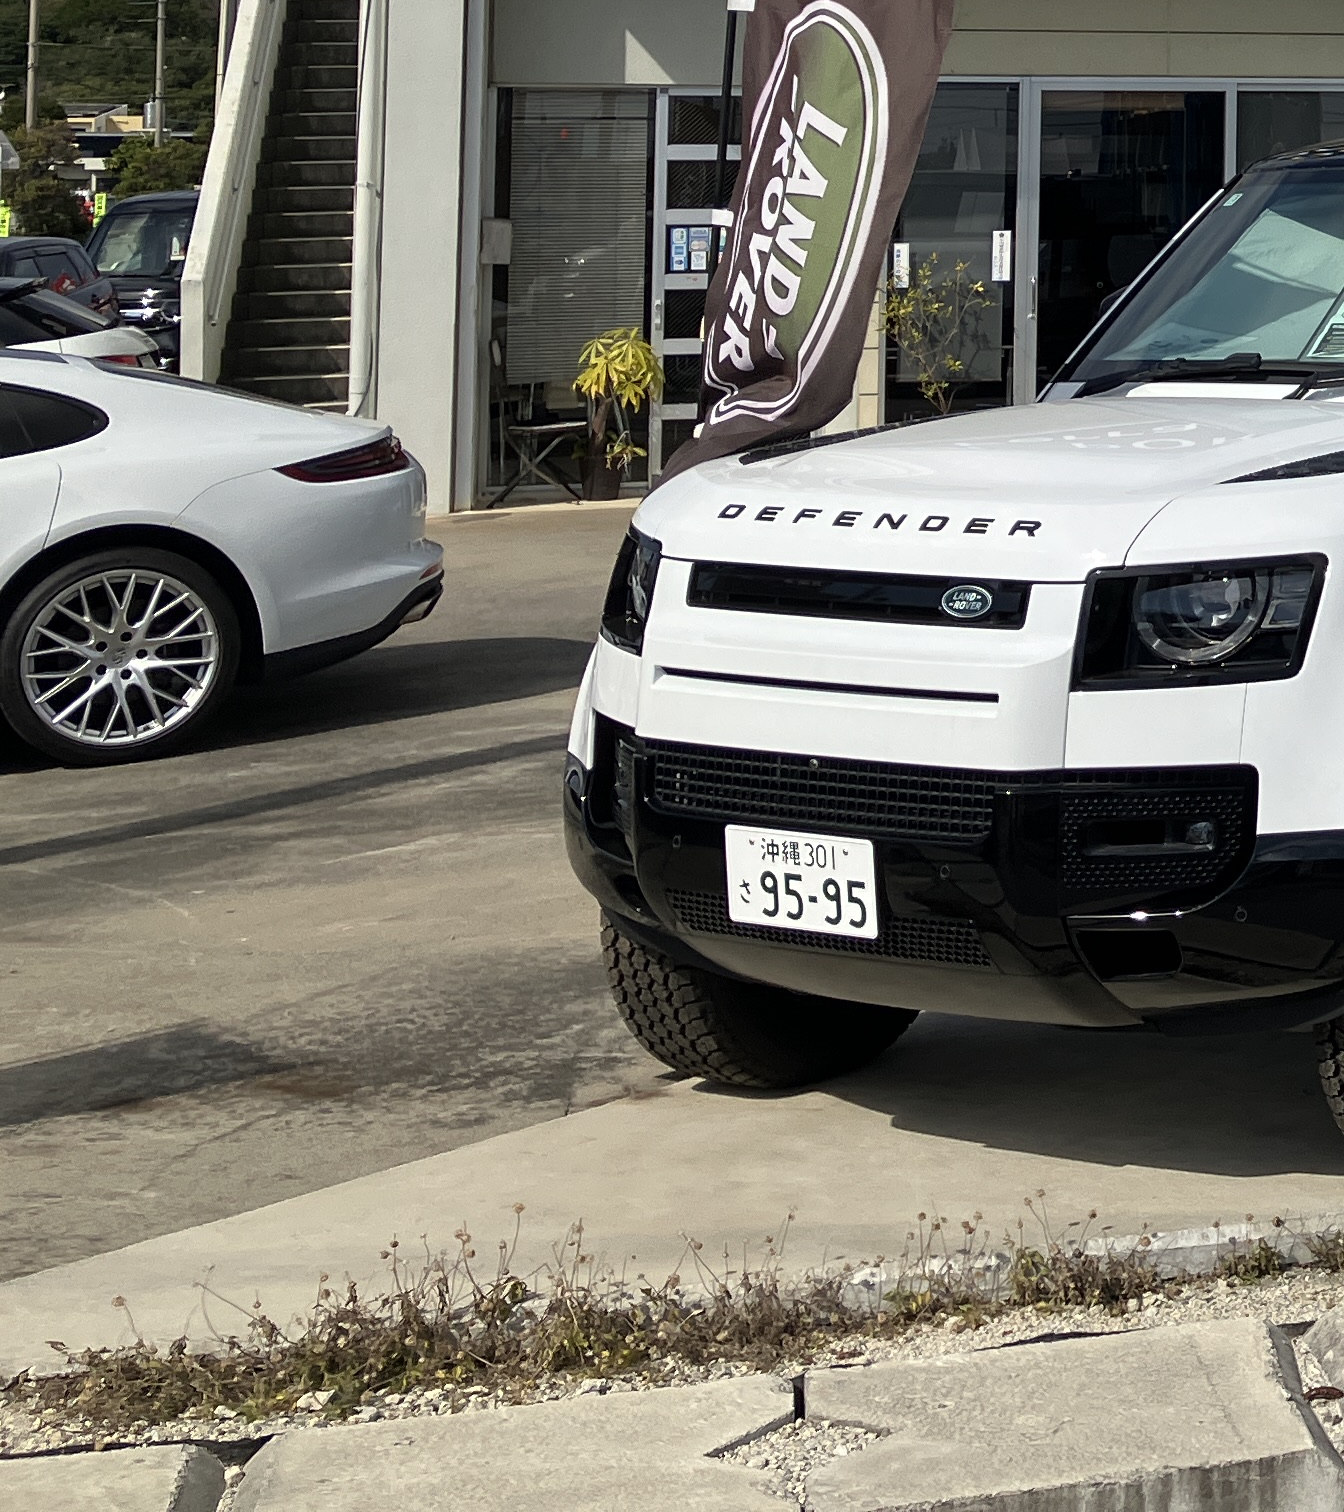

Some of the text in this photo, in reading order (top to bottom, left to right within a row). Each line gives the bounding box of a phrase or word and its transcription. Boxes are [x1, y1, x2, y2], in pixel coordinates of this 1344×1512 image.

[762, 99, 848, 318] LAND
[717, 503, 1042, 537] DEFENDER
[952, 591, 977, 601] LAND
[952, 600, 982, 610] ROVER
[760, 870, 867, 928] 95-95
